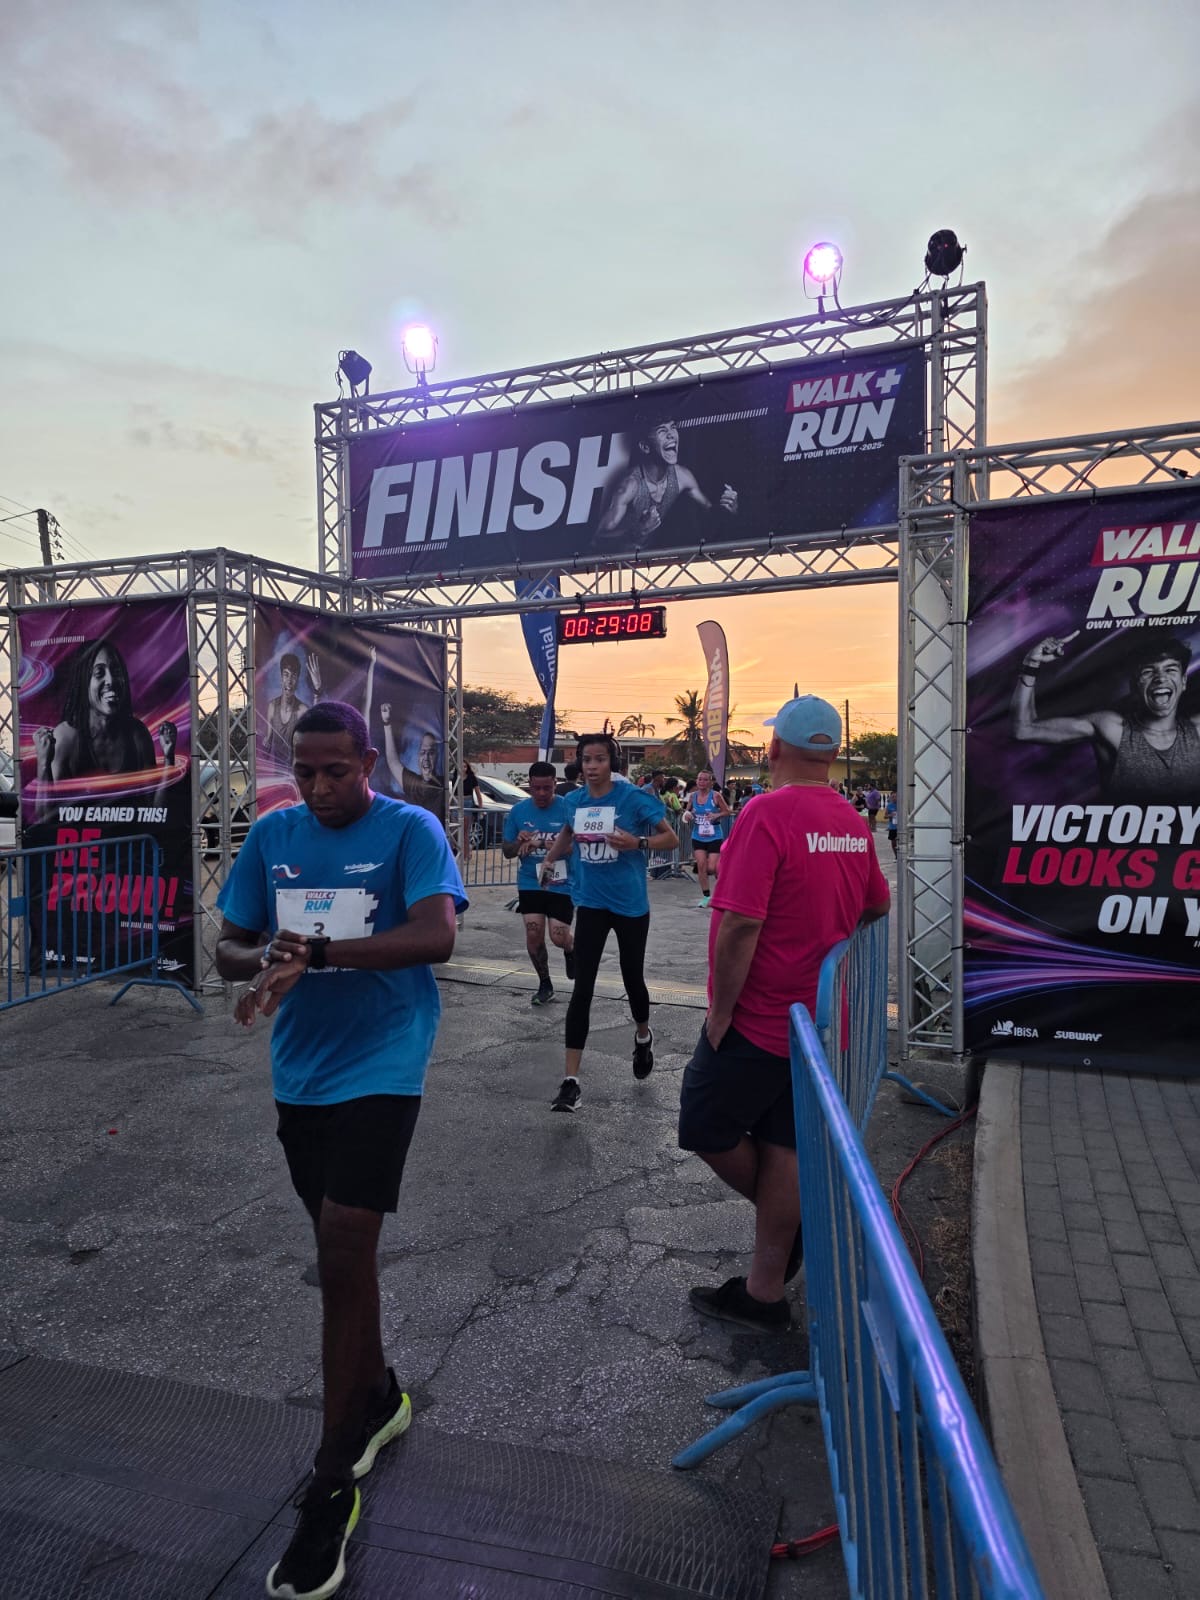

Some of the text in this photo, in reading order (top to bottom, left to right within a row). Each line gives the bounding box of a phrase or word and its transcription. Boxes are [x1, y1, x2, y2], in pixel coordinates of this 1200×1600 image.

[783, 398, 896, 453] RUN
[783, 453, 803, 462] OWN
[803, 449, 824, 459] YOUR
[825, 445, 858, 456] VICTORY
[362, 432, 630, 548] FINISH
[1086, 561, 1200, 619] RU
[564, 613, 652, 638] 00:29:08
[1086, 615, 1198, 630] OWN YOUR VICTORY
[58, 807, 167, 823] YOU EARNED THIS!
[583, 821, 604, 831] 988
[1011, 804, 1200, 845] VICTORY
[54, 828, 102, 868] BE
[1002, 846, 1159, 889] LOOKS
[47, 872, 179, 918] PROUD!
[304, 900, 333, 911] RUN
[1097, 894, 1169, 935] ON
[1054, 1030, 1103, 1042] SUBWAY
